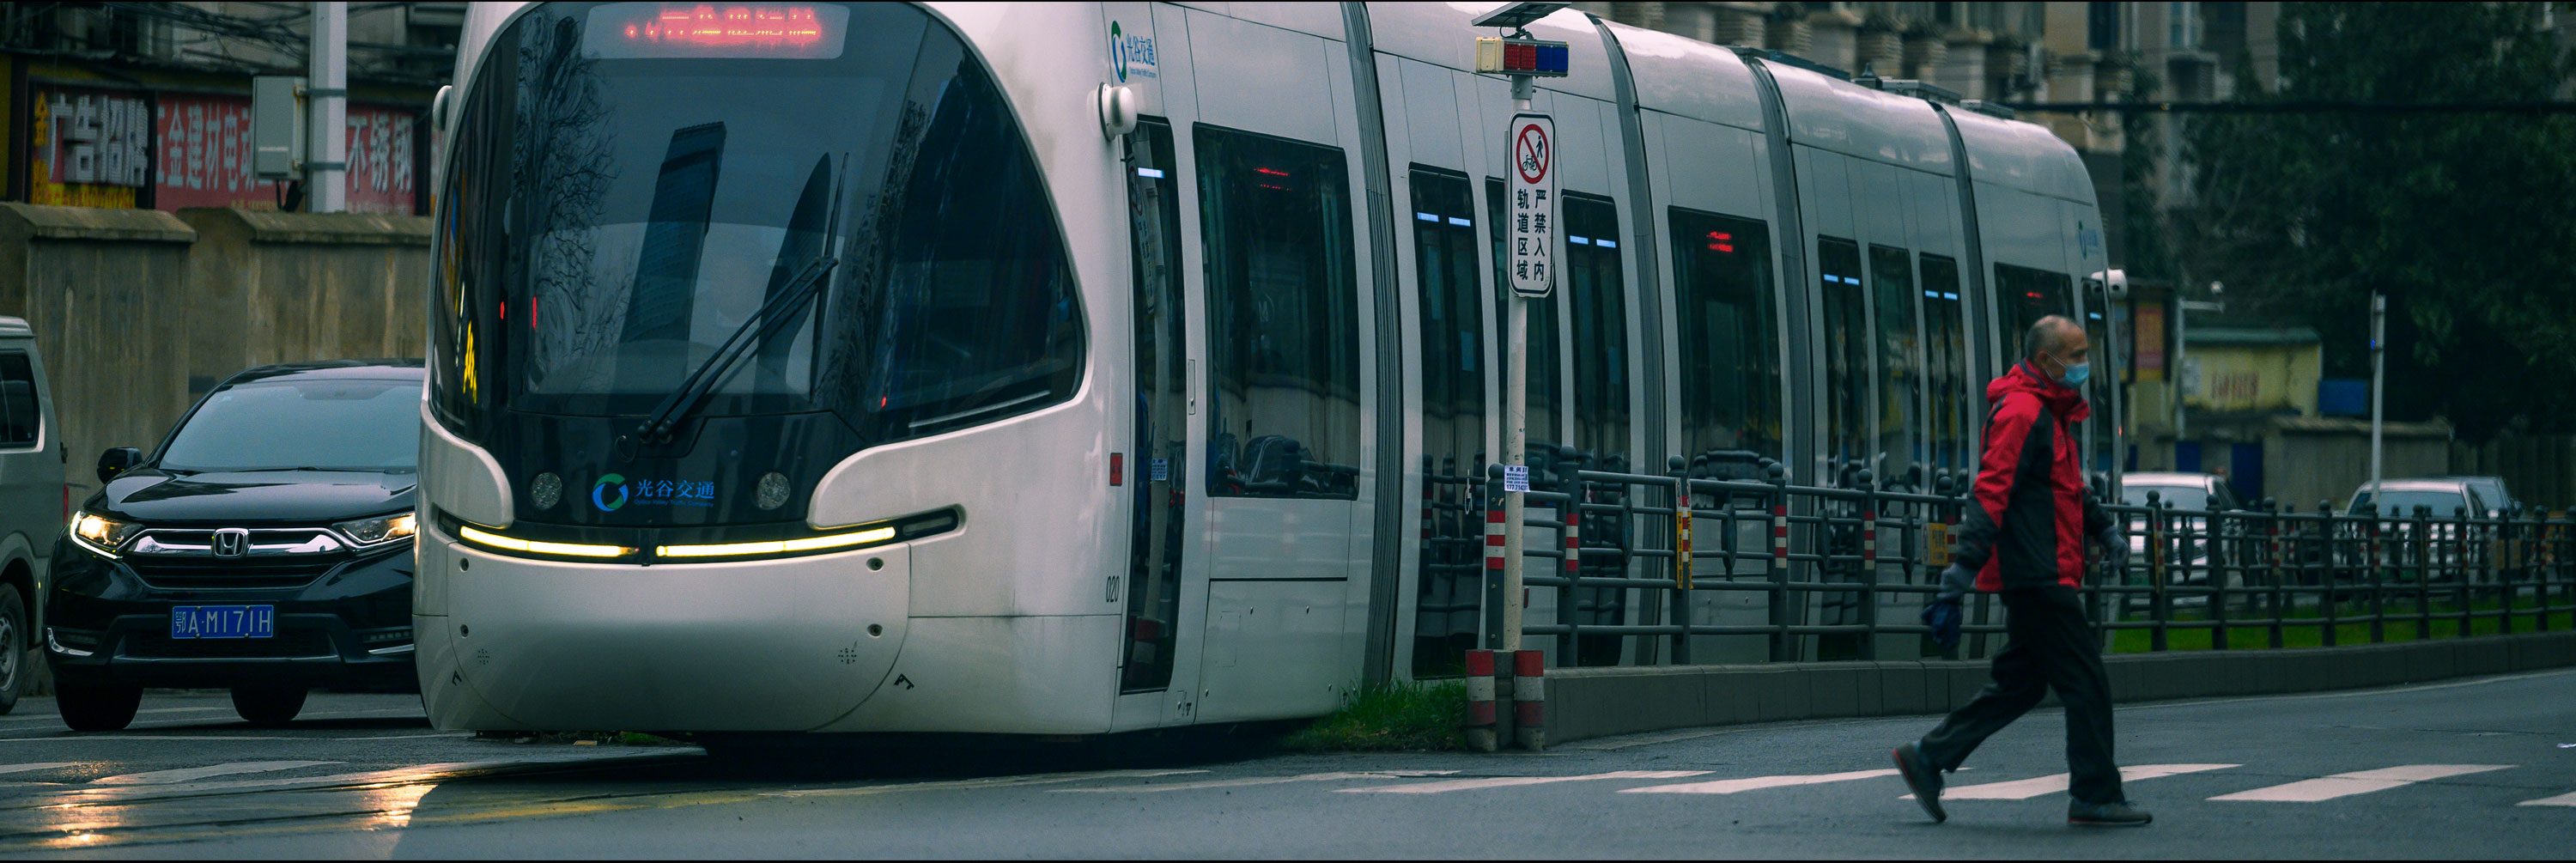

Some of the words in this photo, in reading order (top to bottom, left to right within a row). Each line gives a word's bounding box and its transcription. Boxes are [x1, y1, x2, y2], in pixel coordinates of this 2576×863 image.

[1127, 33, 1156, 66] 光谷交通
[49, 93, 148, 187] 广告招牌
[346, 112, 413, 192] 不锈钢
[1516, 188, 1529, 281] 轨道区域
[1534, 188, 1547, 282] 严禁入内
[635, 478, 715, 499] 光谷交通
[1106, 575, 1120, 602] 020
